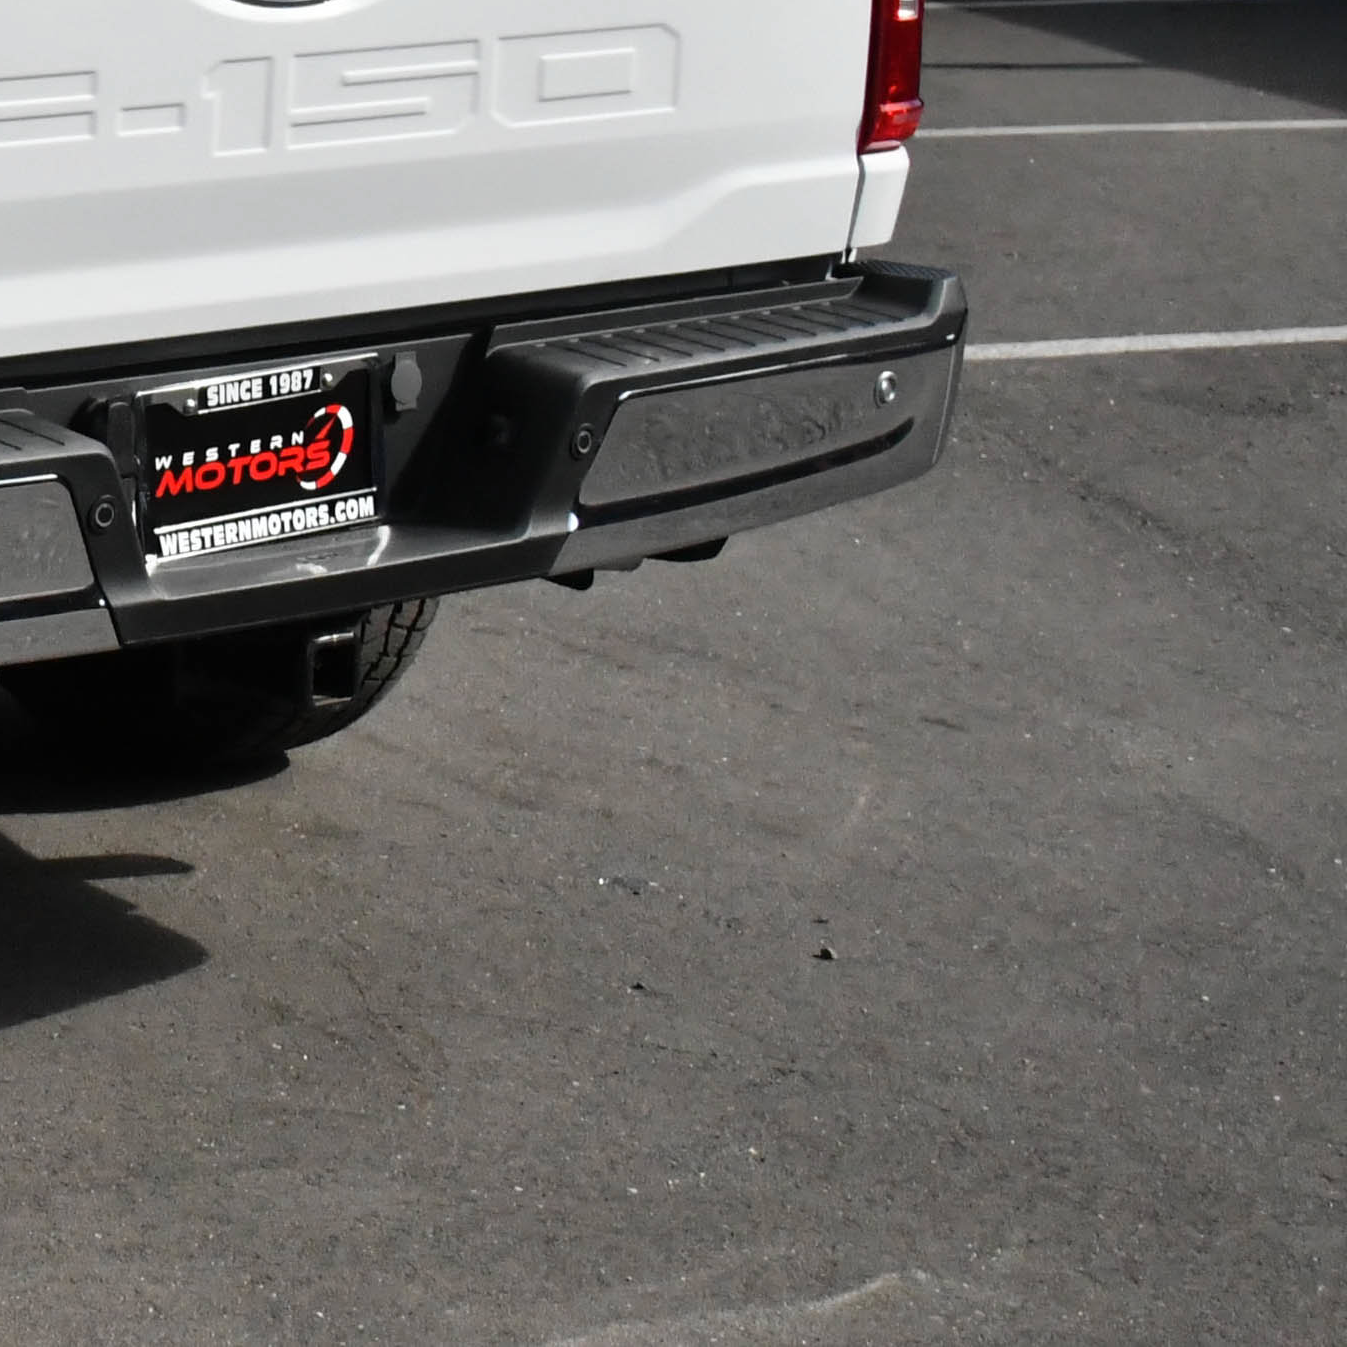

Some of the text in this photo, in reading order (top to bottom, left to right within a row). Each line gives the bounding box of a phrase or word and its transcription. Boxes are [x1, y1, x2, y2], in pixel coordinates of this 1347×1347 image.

[207, 369, 314, 407] SINCE 1987
[155, 430, 305, 471] WESTERN
[155, 439, 332, 498] MOTORS
[159, 495, 375, 556] WESTERNMOTORS.COM
